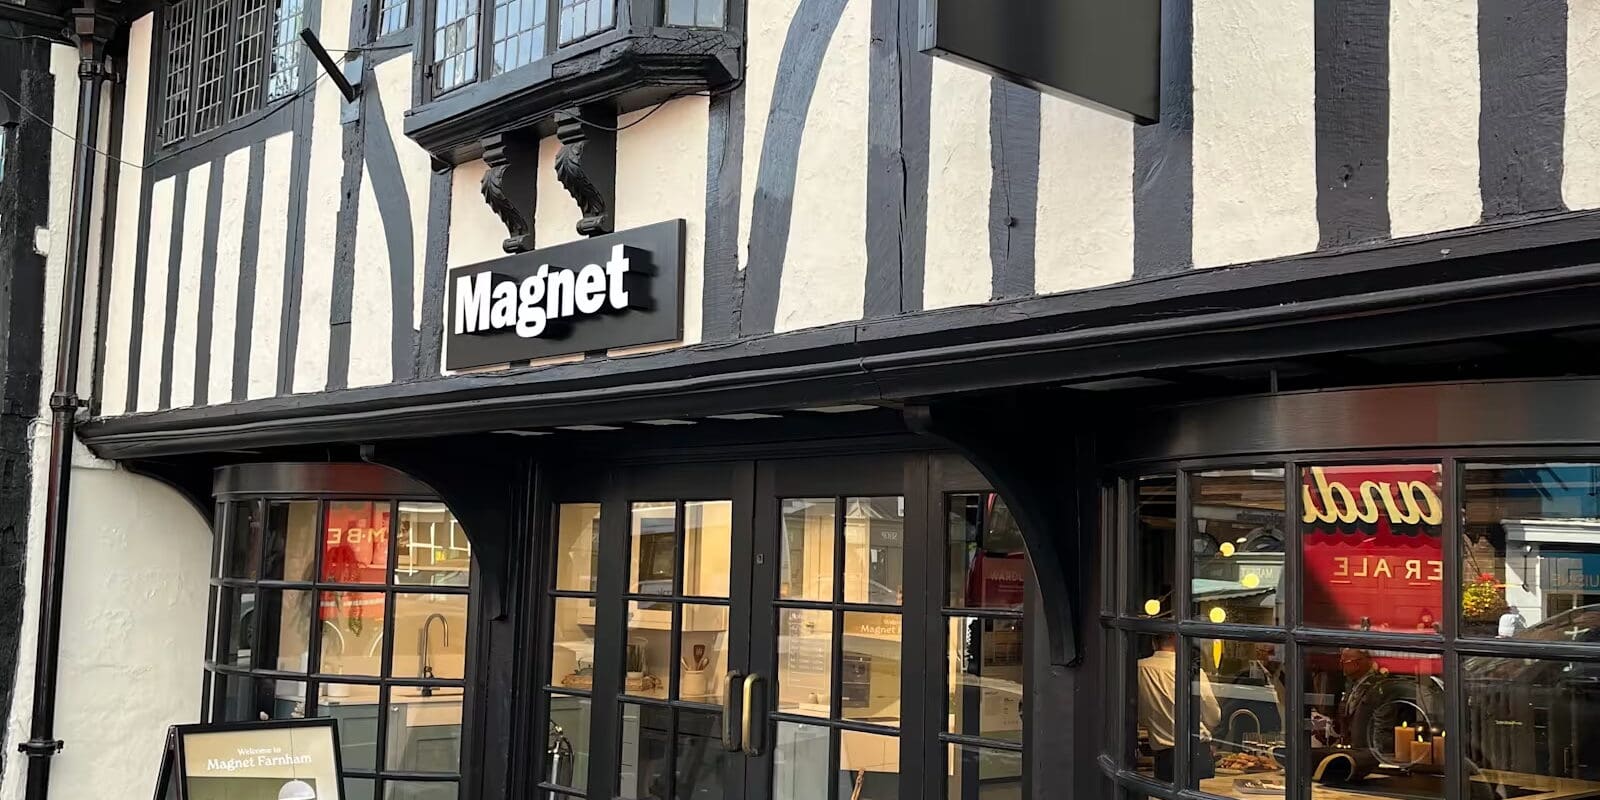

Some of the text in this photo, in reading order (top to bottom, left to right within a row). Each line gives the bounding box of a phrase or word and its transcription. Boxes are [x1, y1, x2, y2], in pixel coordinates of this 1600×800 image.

[455, 243, 630, 338] Magnet
[860, 624, 896, 636] Magnet
[237, 746, 282, 756] Welcome to
[207, 753, 312, 771] Magnet Farnham
